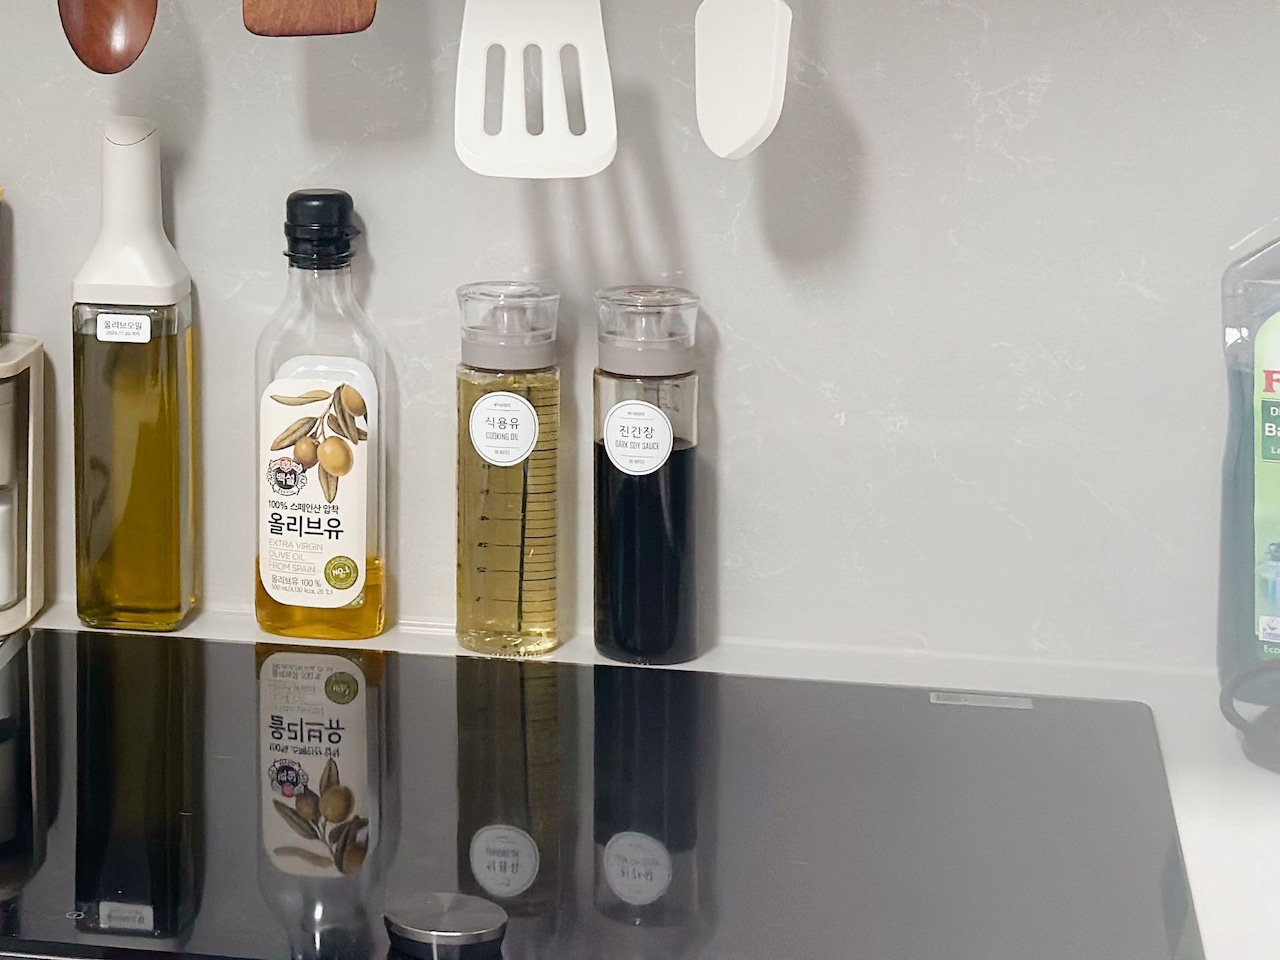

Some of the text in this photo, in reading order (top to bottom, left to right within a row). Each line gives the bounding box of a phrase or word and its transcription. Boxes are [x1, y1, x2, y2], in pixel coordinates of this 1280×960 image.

[104, 321, 142, 330] 올리브오일
[485, 417, 520, 430] 식용유
[485, 431, 519, 441] COOKING OIL
[619, 425, 655, 439] 진간장
[615, 439, 659, 450] DARK SOY SAUCE
[276, 472, 296, 486] 백설
[268, 500, 339, 515] 100% 스페인산 압착
[268, 512, 344, 540] 올리브유
[269, 538, 323, 551] EXTRA VIRGIN
[269, 550, 306, 561] OLIVE OIL
[268, 561, 316, 573] FROM SPAIN
[332, 566, 350, 576] NO.1
[271, 574, 298, 586] 올리브유
